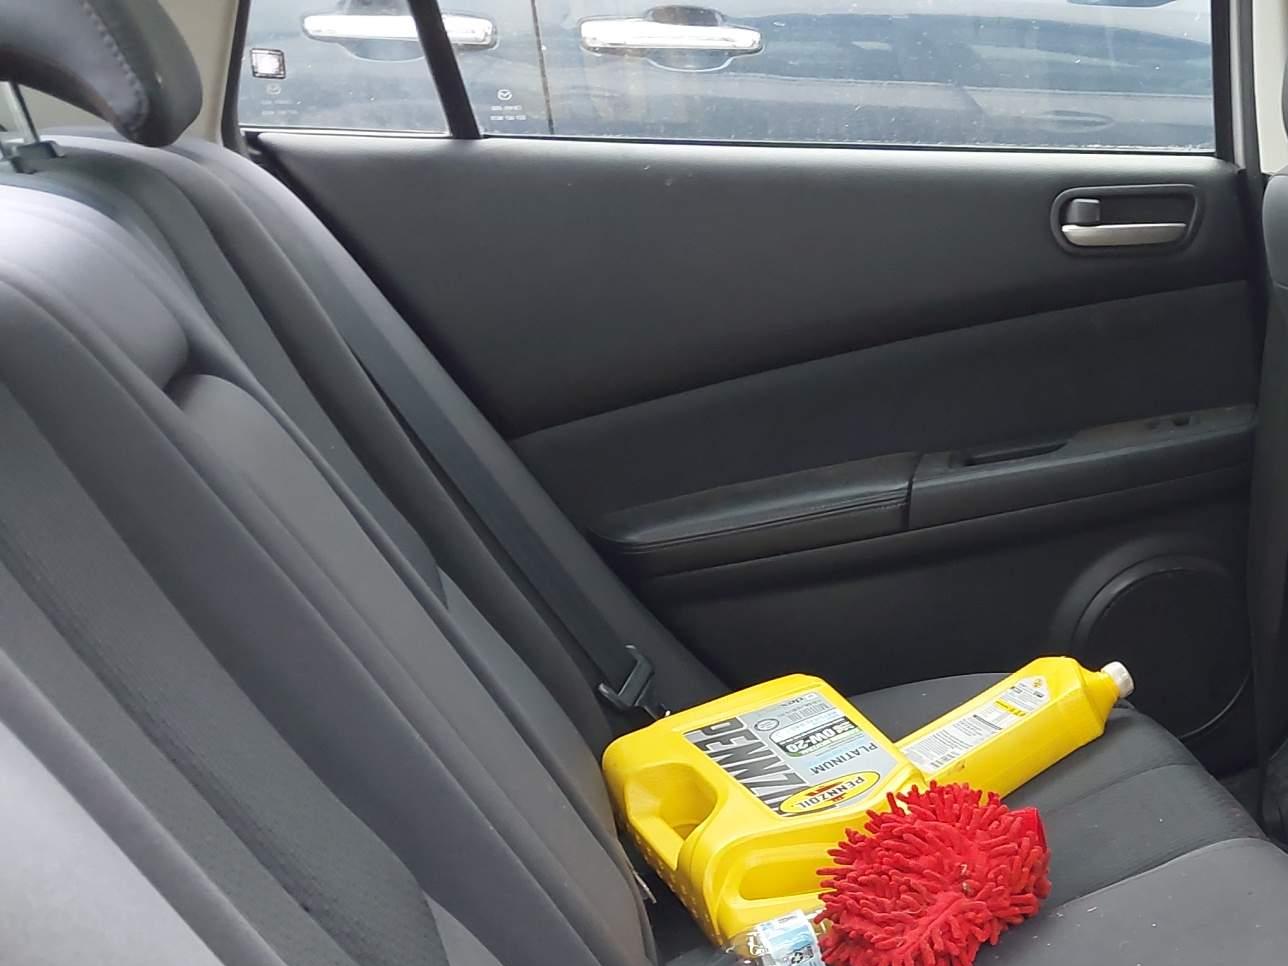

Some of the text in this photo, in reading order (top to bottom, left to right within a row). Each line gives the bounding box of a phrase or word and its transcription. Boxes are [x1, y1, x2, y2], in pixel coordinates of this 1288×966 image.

[785, 725, 834, 753] 0W-20
[810, 742, 878, 775] PLATINUM
[794, 776, 865, 809] PENNZOIL
